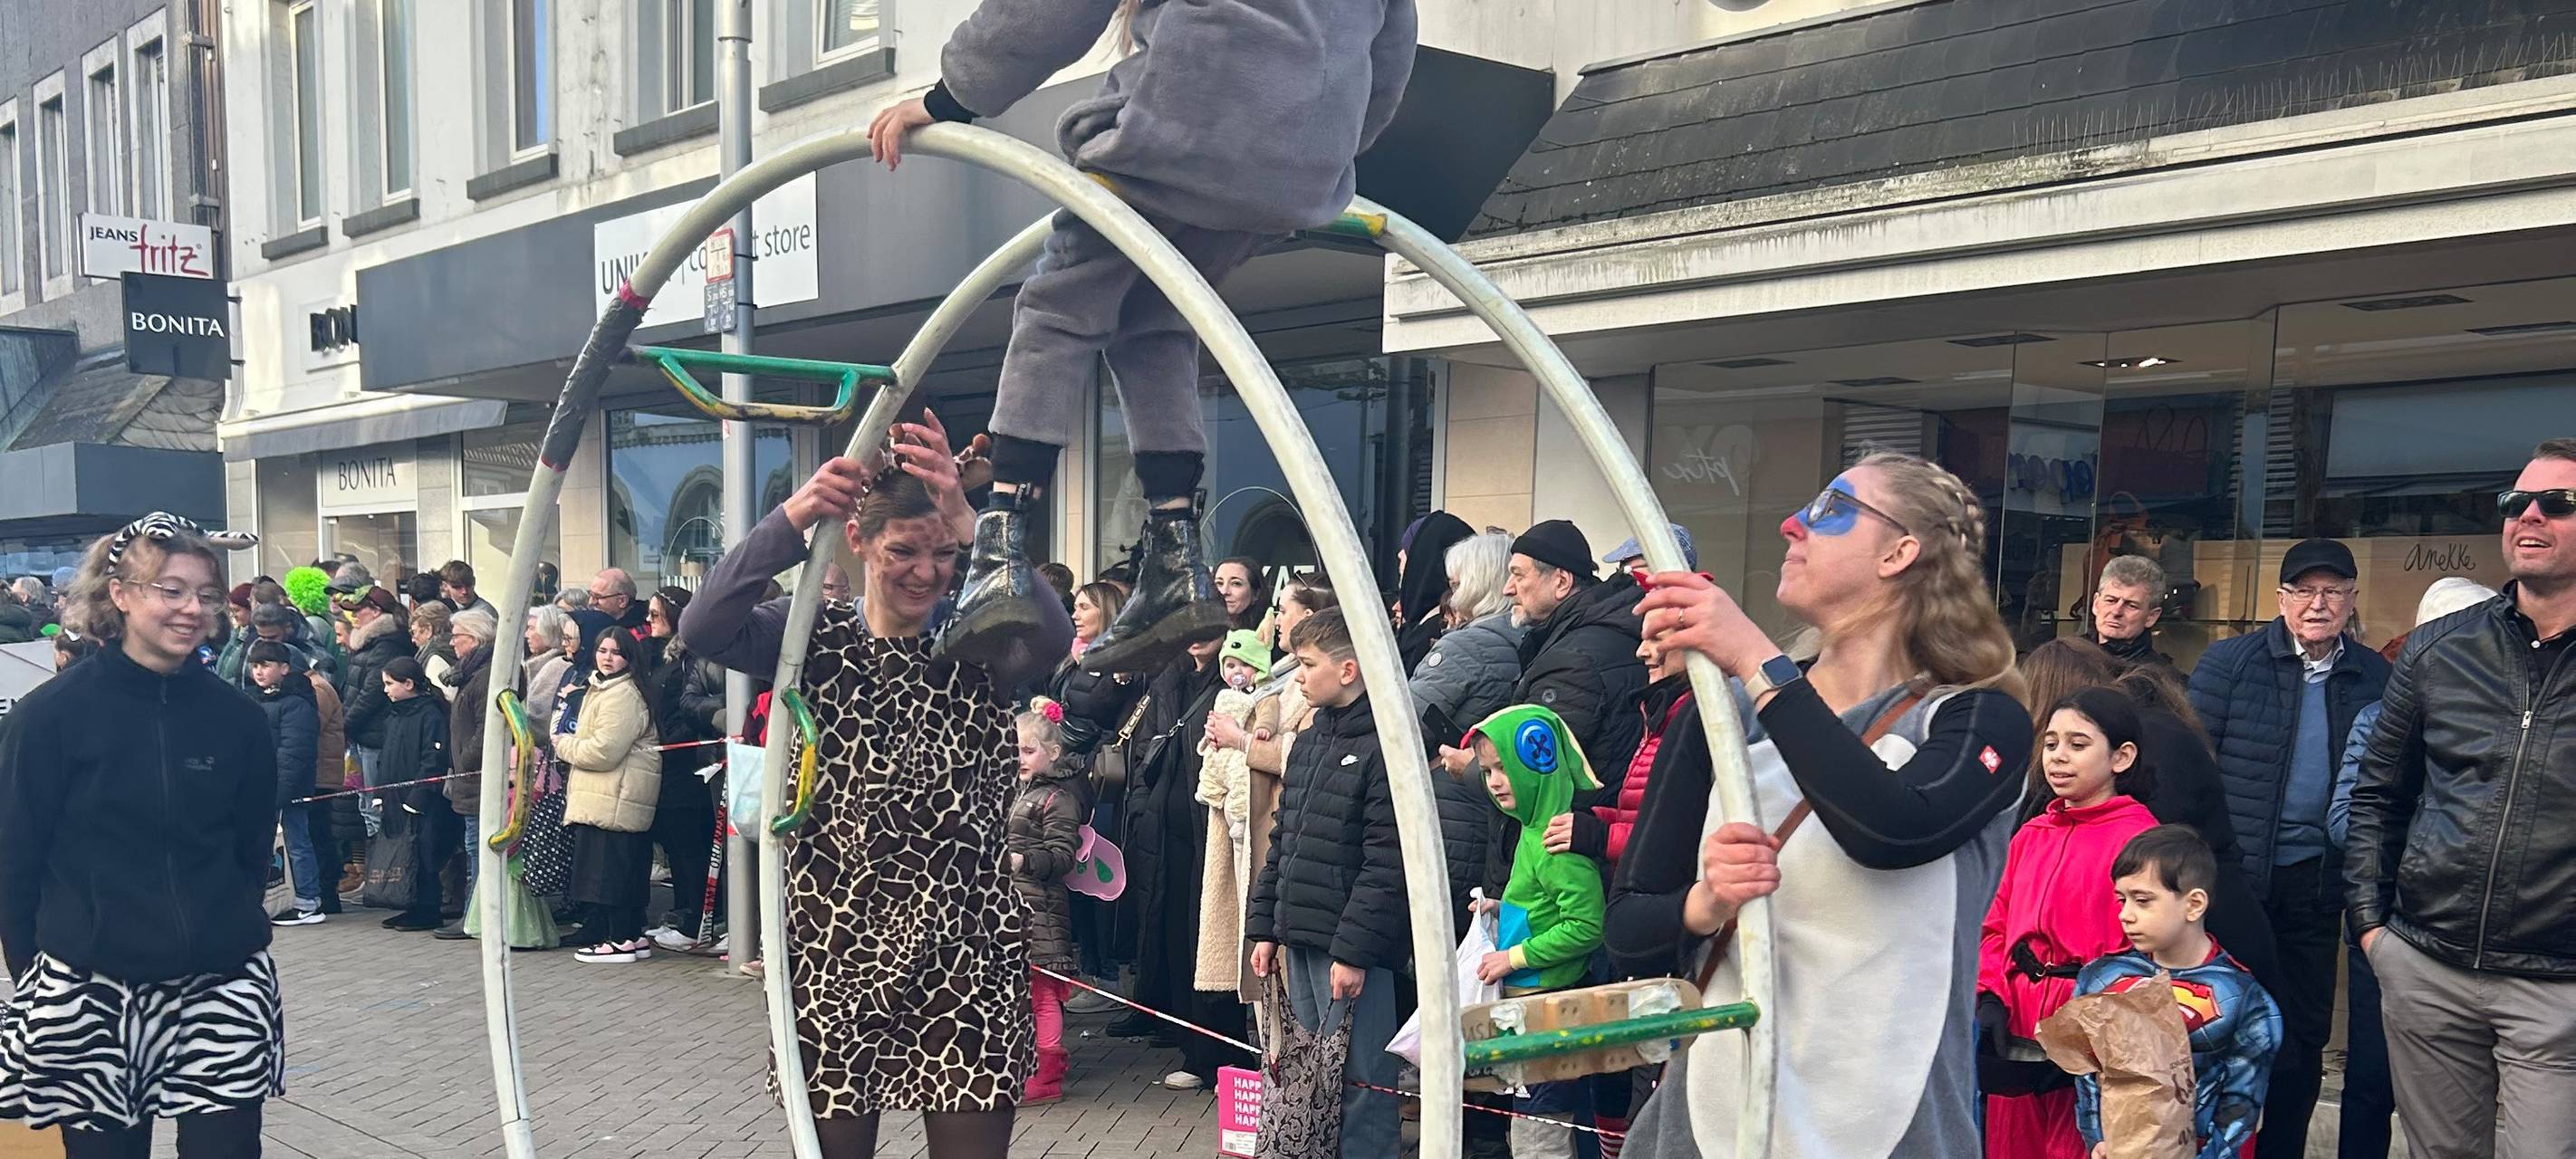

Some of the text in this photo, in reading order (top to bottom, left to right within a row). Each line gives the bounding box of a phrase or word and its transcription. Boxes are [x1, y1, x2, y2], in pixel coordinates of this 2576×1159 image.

[90, 224, 209, 276] JEANS fritz
[601, 251, 671, 294] UNI
[764, 224, 811, 257] store
[131, 311, 225, 338] BONITA
[339, 456, 397, 491] BONITA
